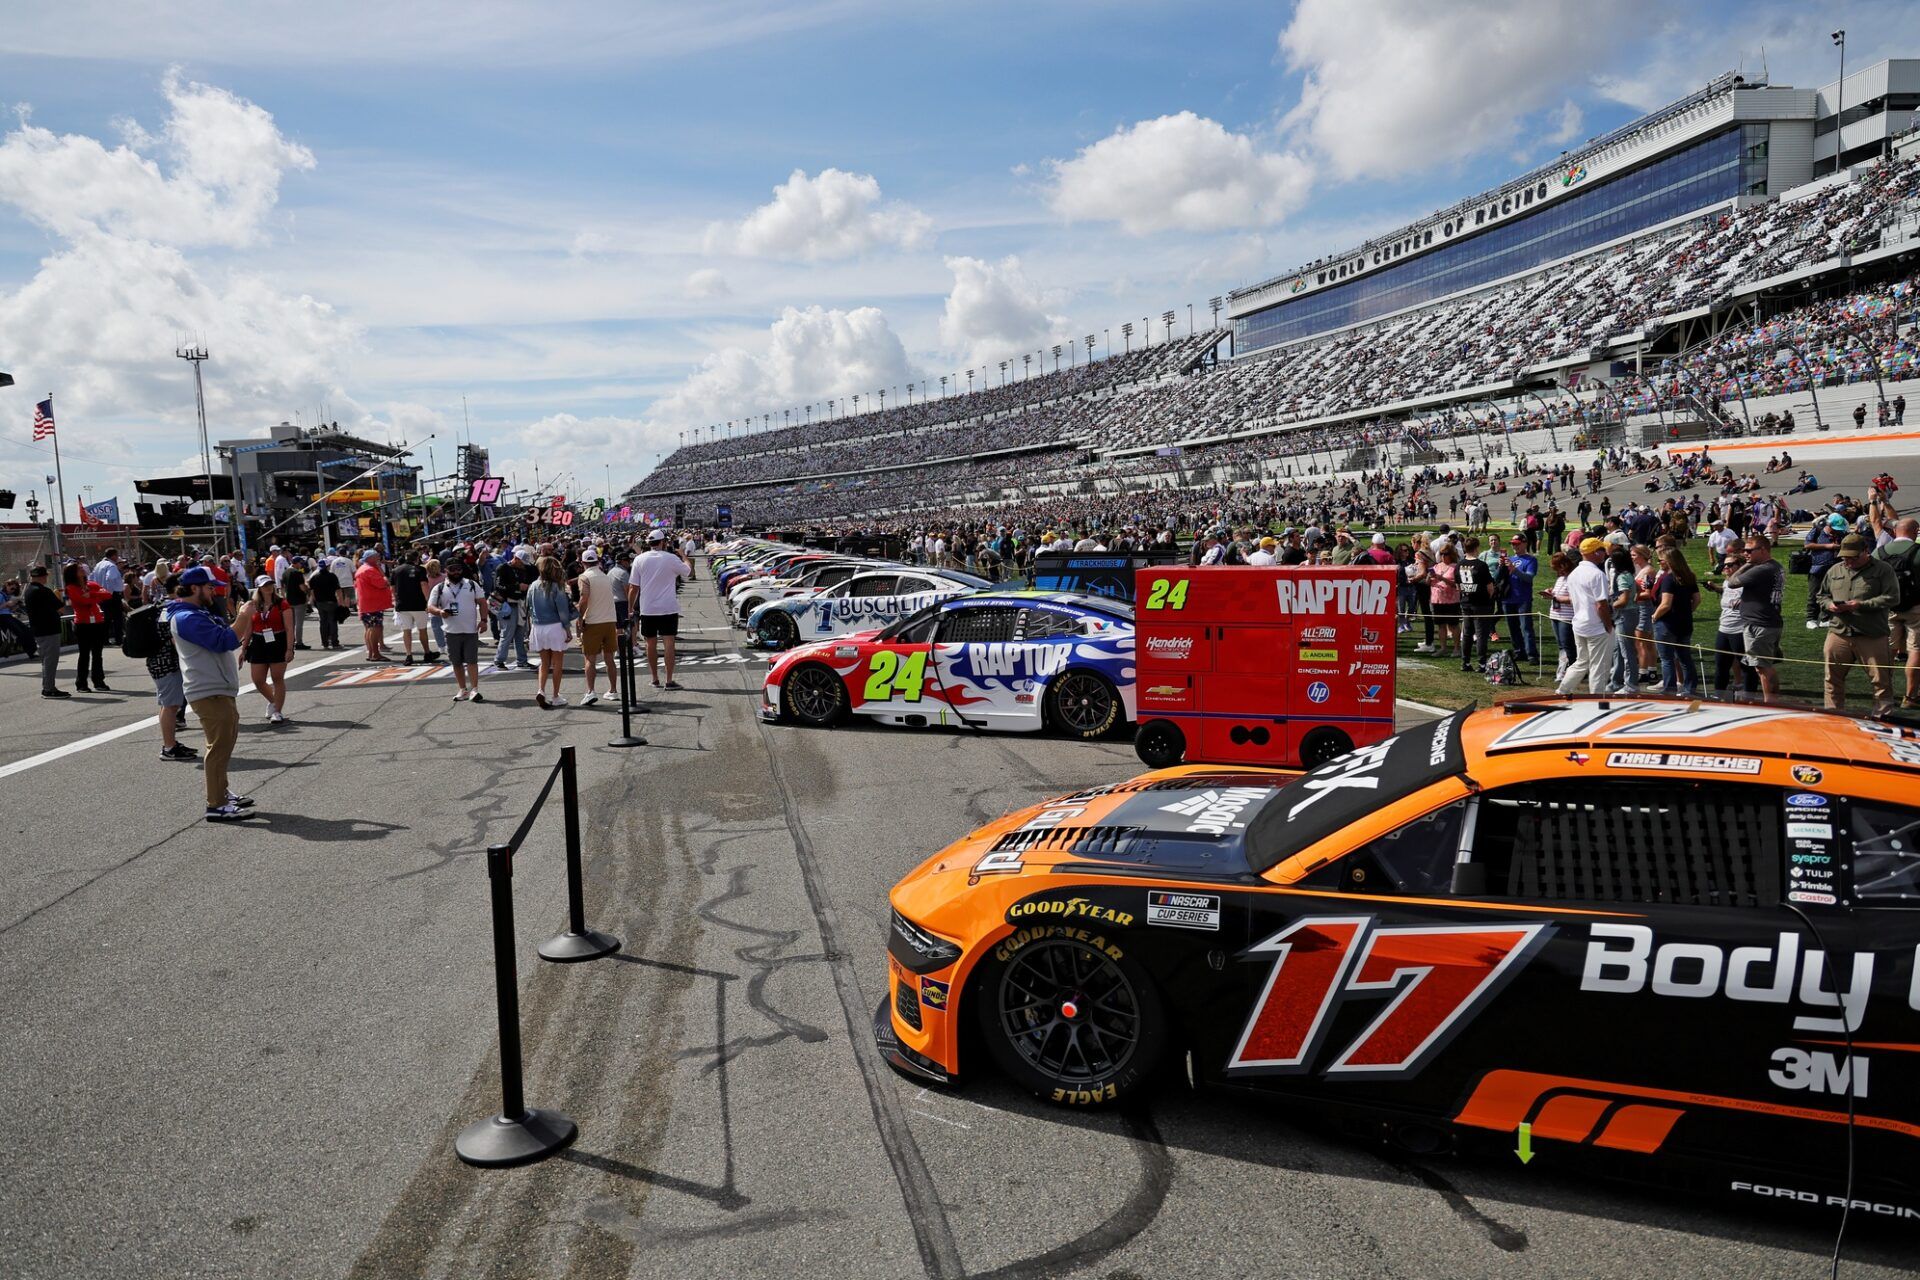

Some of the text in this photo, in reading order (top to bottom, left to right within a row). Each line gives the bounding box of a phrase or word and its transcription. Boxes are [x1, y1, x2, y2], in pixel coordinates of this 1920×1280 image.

[1317, 182, 1548, 285] WORLD CENTER OF RACING
[469, 480, 501, 502] 19
[89, 504, 113, 514] USCH
[552, 510, 573, 526] 20
[580, 507, 600, 520] 48
[1459, 569, 1474, 584] 8
[1146, 579, 1190, 610] 24
[1276, 579, 1391, 614] RAPTOR
[839, 597, 898, 617] BUSCH
[815, 602, 835, 634] 1
[1300, 627, 1337, 638] ALL-PRO
[1146, 636, 1193, 651] Hendrick
[969, 643, 1073, 676] RAPTOR
[864, 650, 929, 701] 24
[1052, 672, 1072, 693] EAGLE
[1310, 682, 1327, 703] hp
[1082, 699, 1118, 738] GOODYEAR
[1607, 752, 1763, 773] CHRIS BUESCHER
[1800, 774, 1817, 783] 16
[1185, 787, 1272, 835] Mosaic
[1791, 854, 1831, 865] syspro
[1805, 869, 1834, 878] TULIP
[1799, 881, 1833, 892] Trimble
[1170, 895, 1210, 908] NASCAR
[1799, 893, 1833, 903] Castrol
[1009, 898, 1134, 927] GOODYEAR
[1156, 909, 1210, 923] CUP SERIES
[995, 925, 1125, 962] GOODYEAR
[1580, 922, 1875, 1033] Body
[1226, 914, 1547, 1074] 17
[1768, 1047, 1870, 1098] 3M
[1051, 1082, 1117, 1105] EAGLE
[1731, 1181, 1819, 1203] FORD
